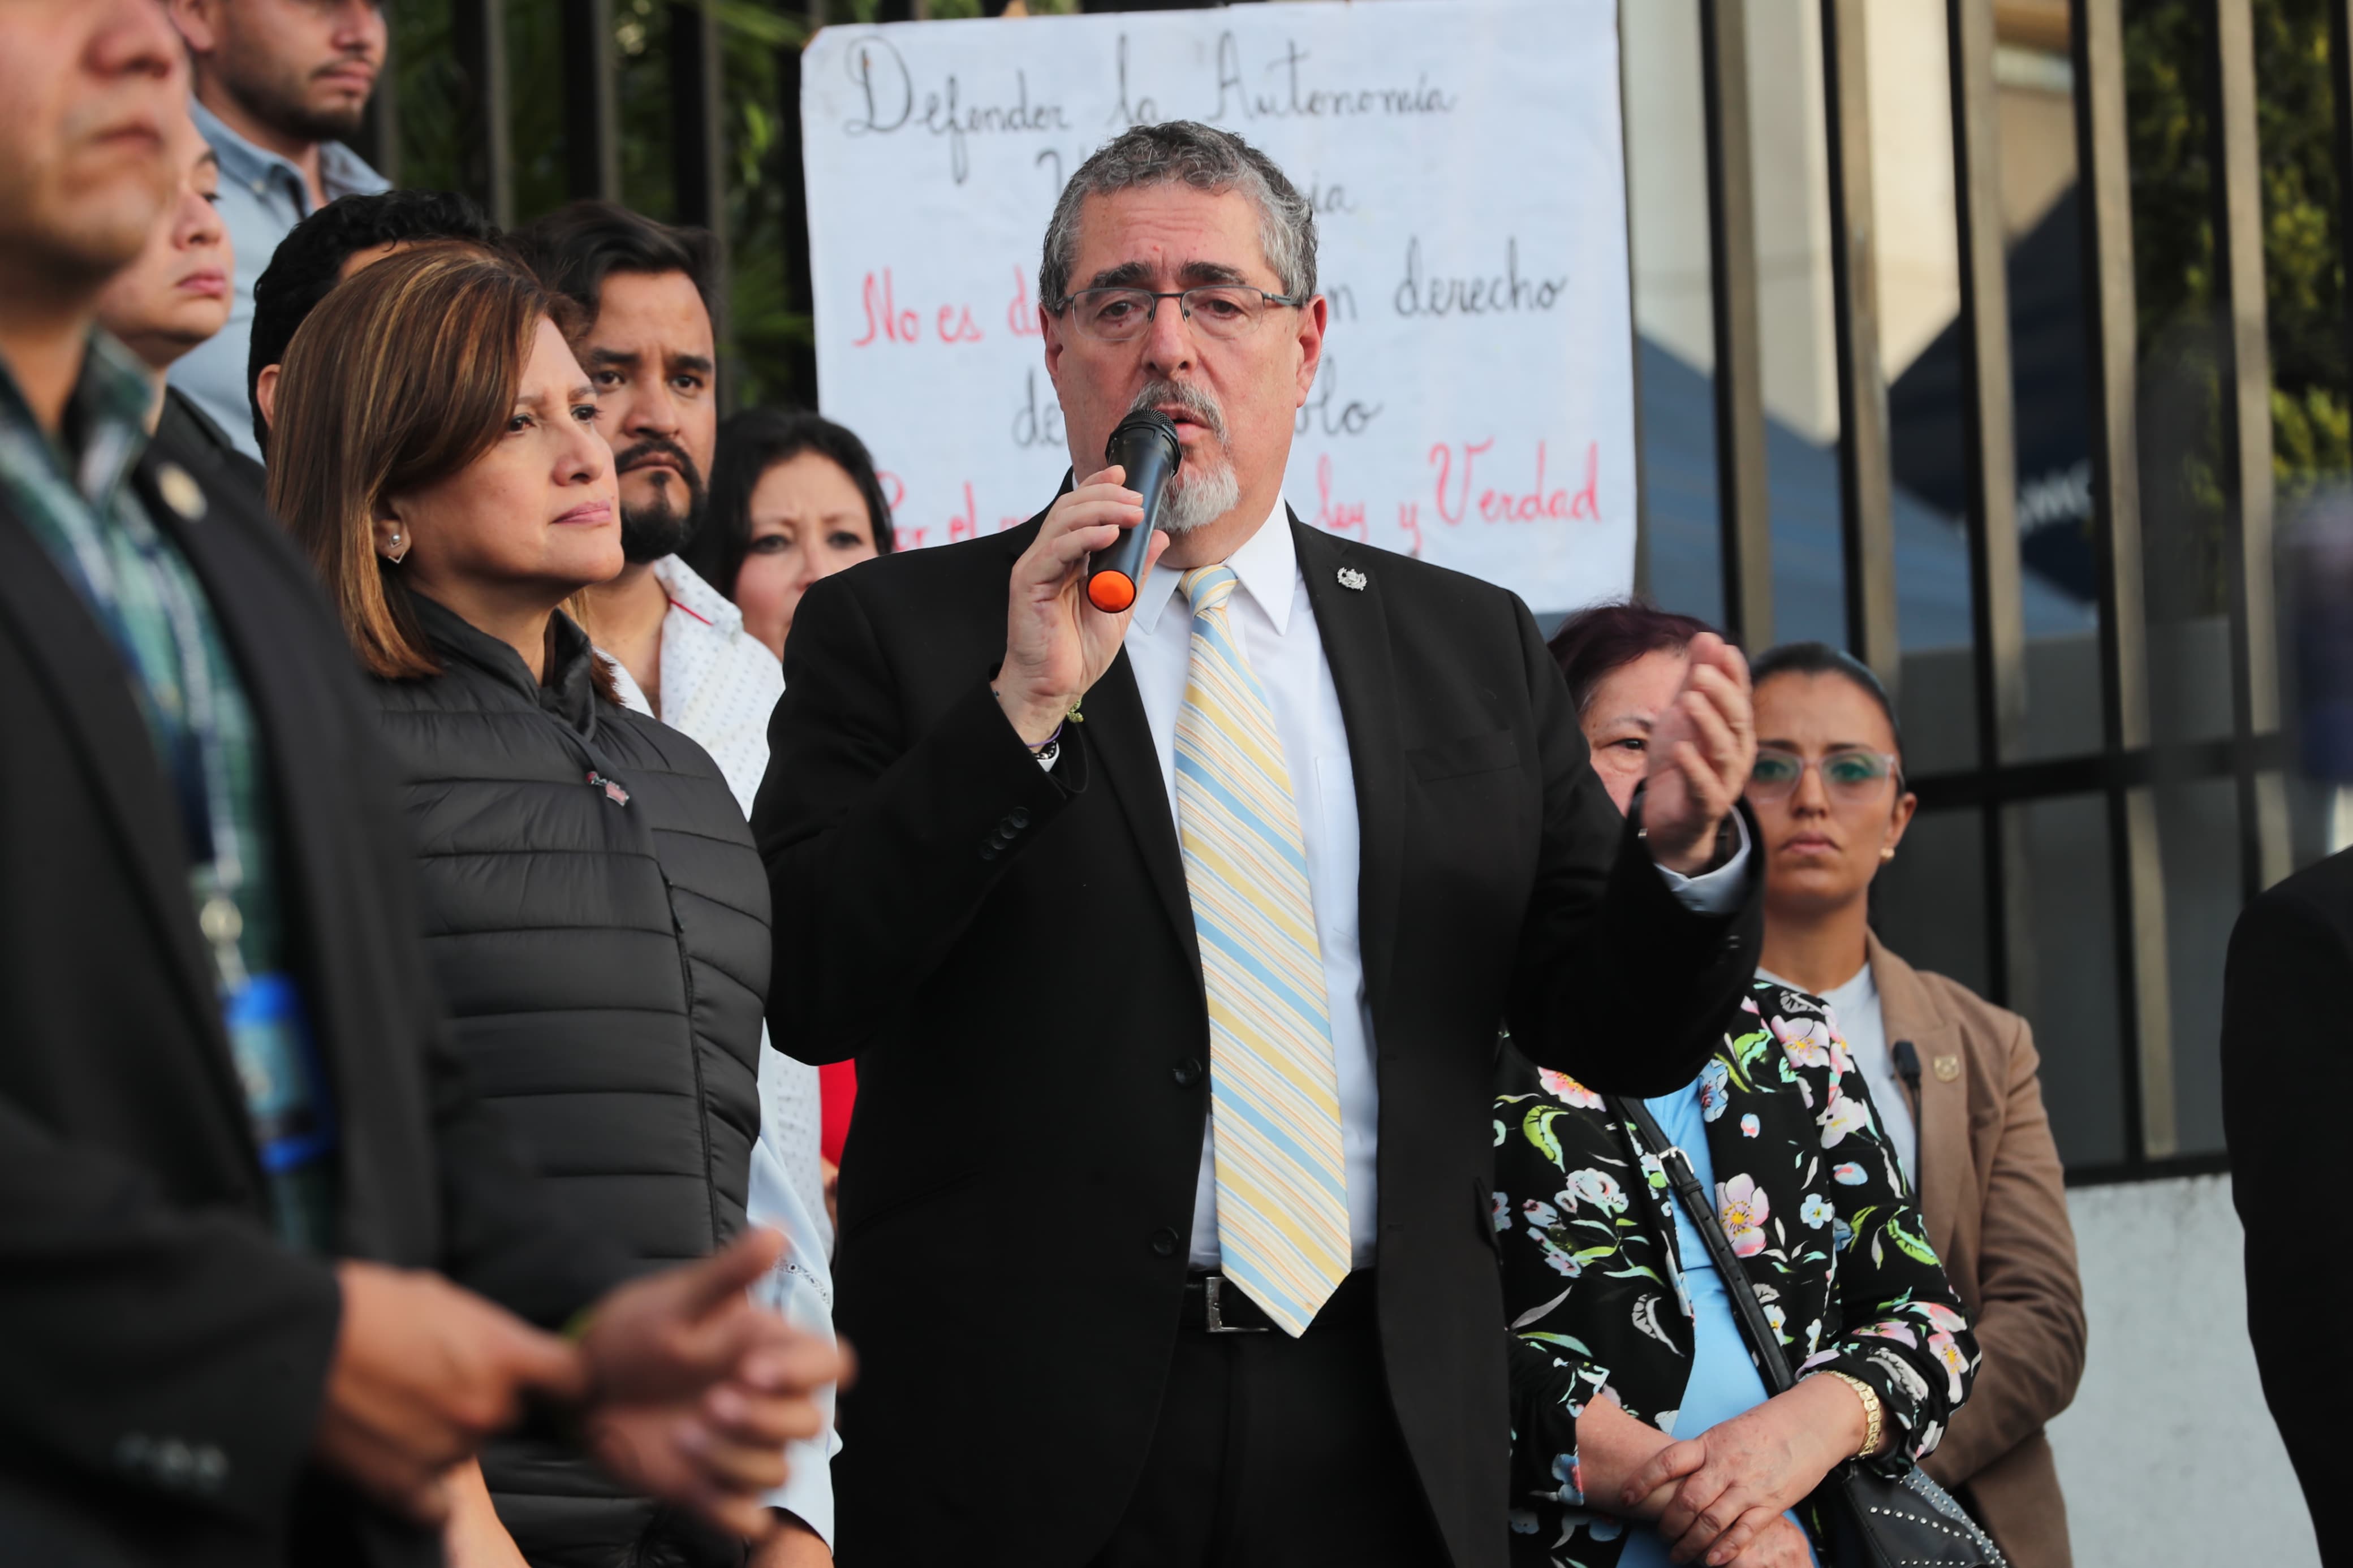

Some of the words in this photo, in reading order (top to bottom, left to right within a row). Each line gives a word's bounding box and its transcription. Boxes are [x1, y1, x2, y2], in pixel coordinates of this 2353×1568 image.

[842, 35, 1071, 187] Defender
[1105, 32, 1161, 128] la
[1205, 29, 1459, 122] Autonomía
[853, 267, 919, 346] No
[937, 304, 984, 344] es
[1394, 235, 1568, 317] derecho
[1397, 500, 1423, 559] y
[1429, 435, 1603, 526] Verdad
